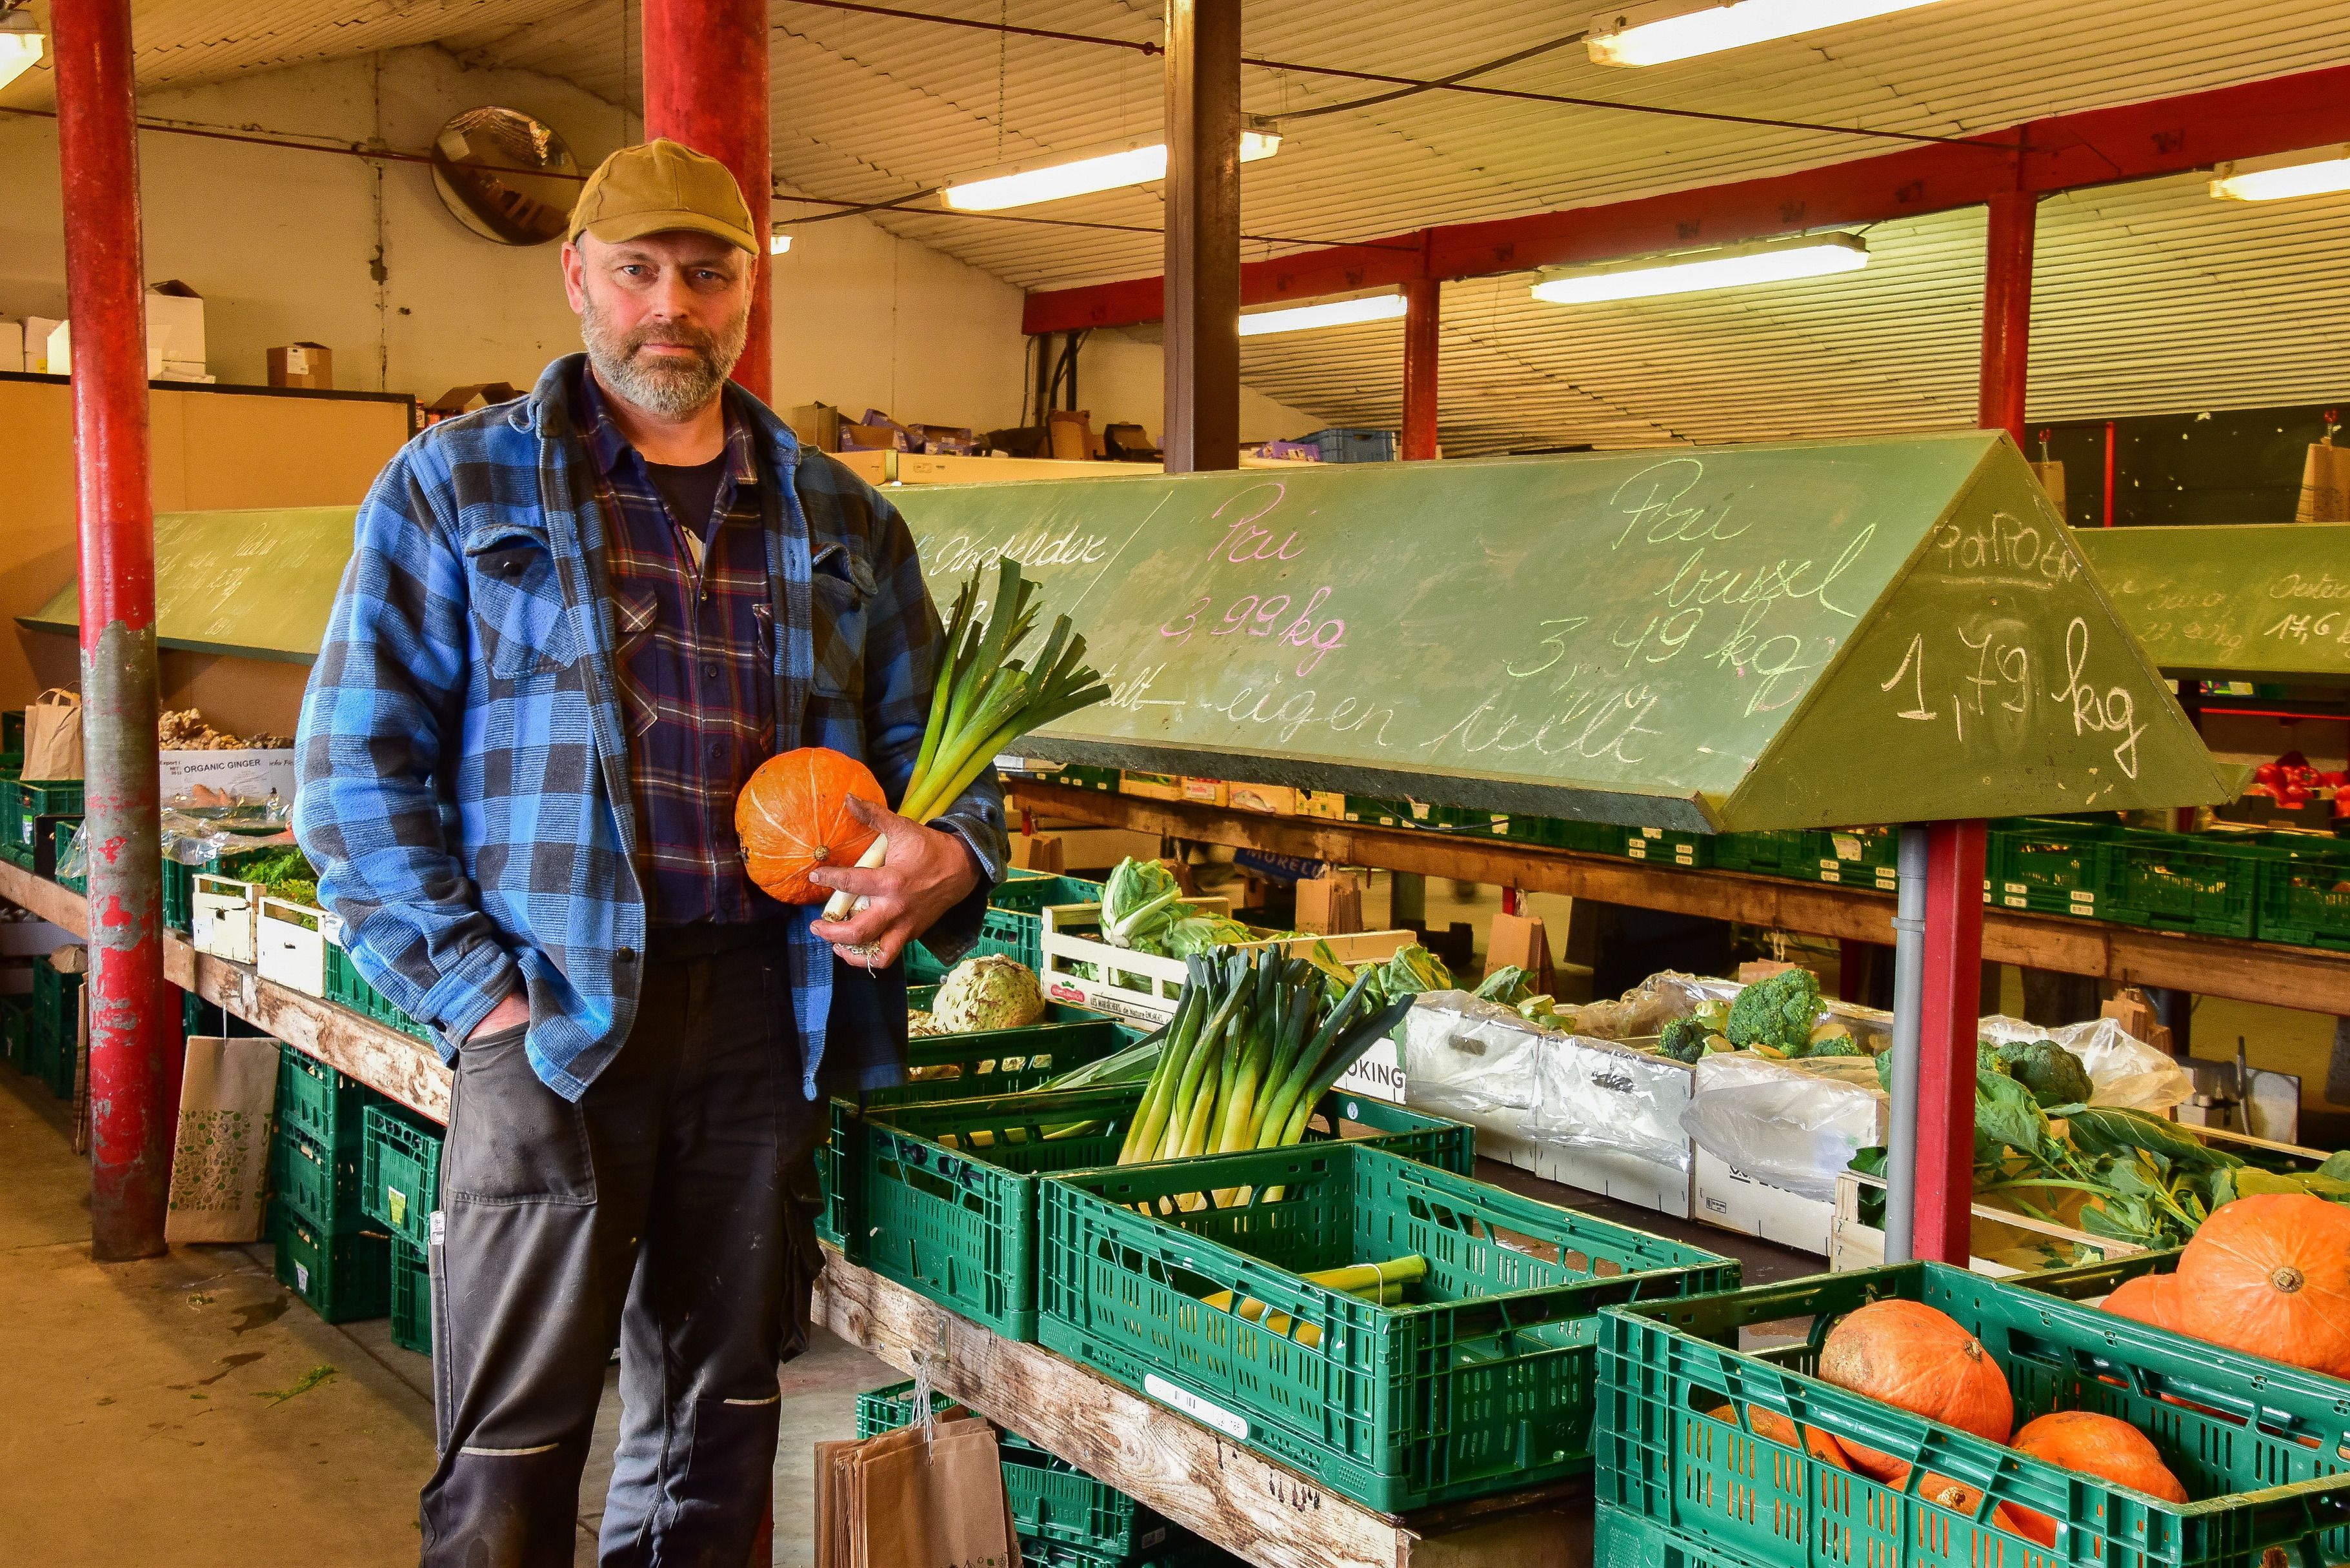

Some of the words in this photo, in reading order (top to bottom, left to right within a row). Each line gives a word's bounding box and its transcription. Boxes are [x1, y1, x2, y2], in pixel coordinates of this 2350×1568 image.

[1278, 586, 1347, 677] kg
[1502, 607, 1703, 695] 3,49
[1704, 598, 1811, 717] kg
[1881, 626, 2028, 742] 1,79
[2051, 617, 2148, 779] kg
[183, 763, 225, 774] ORGANIC
[227, 758, 261, 769] GINGER
